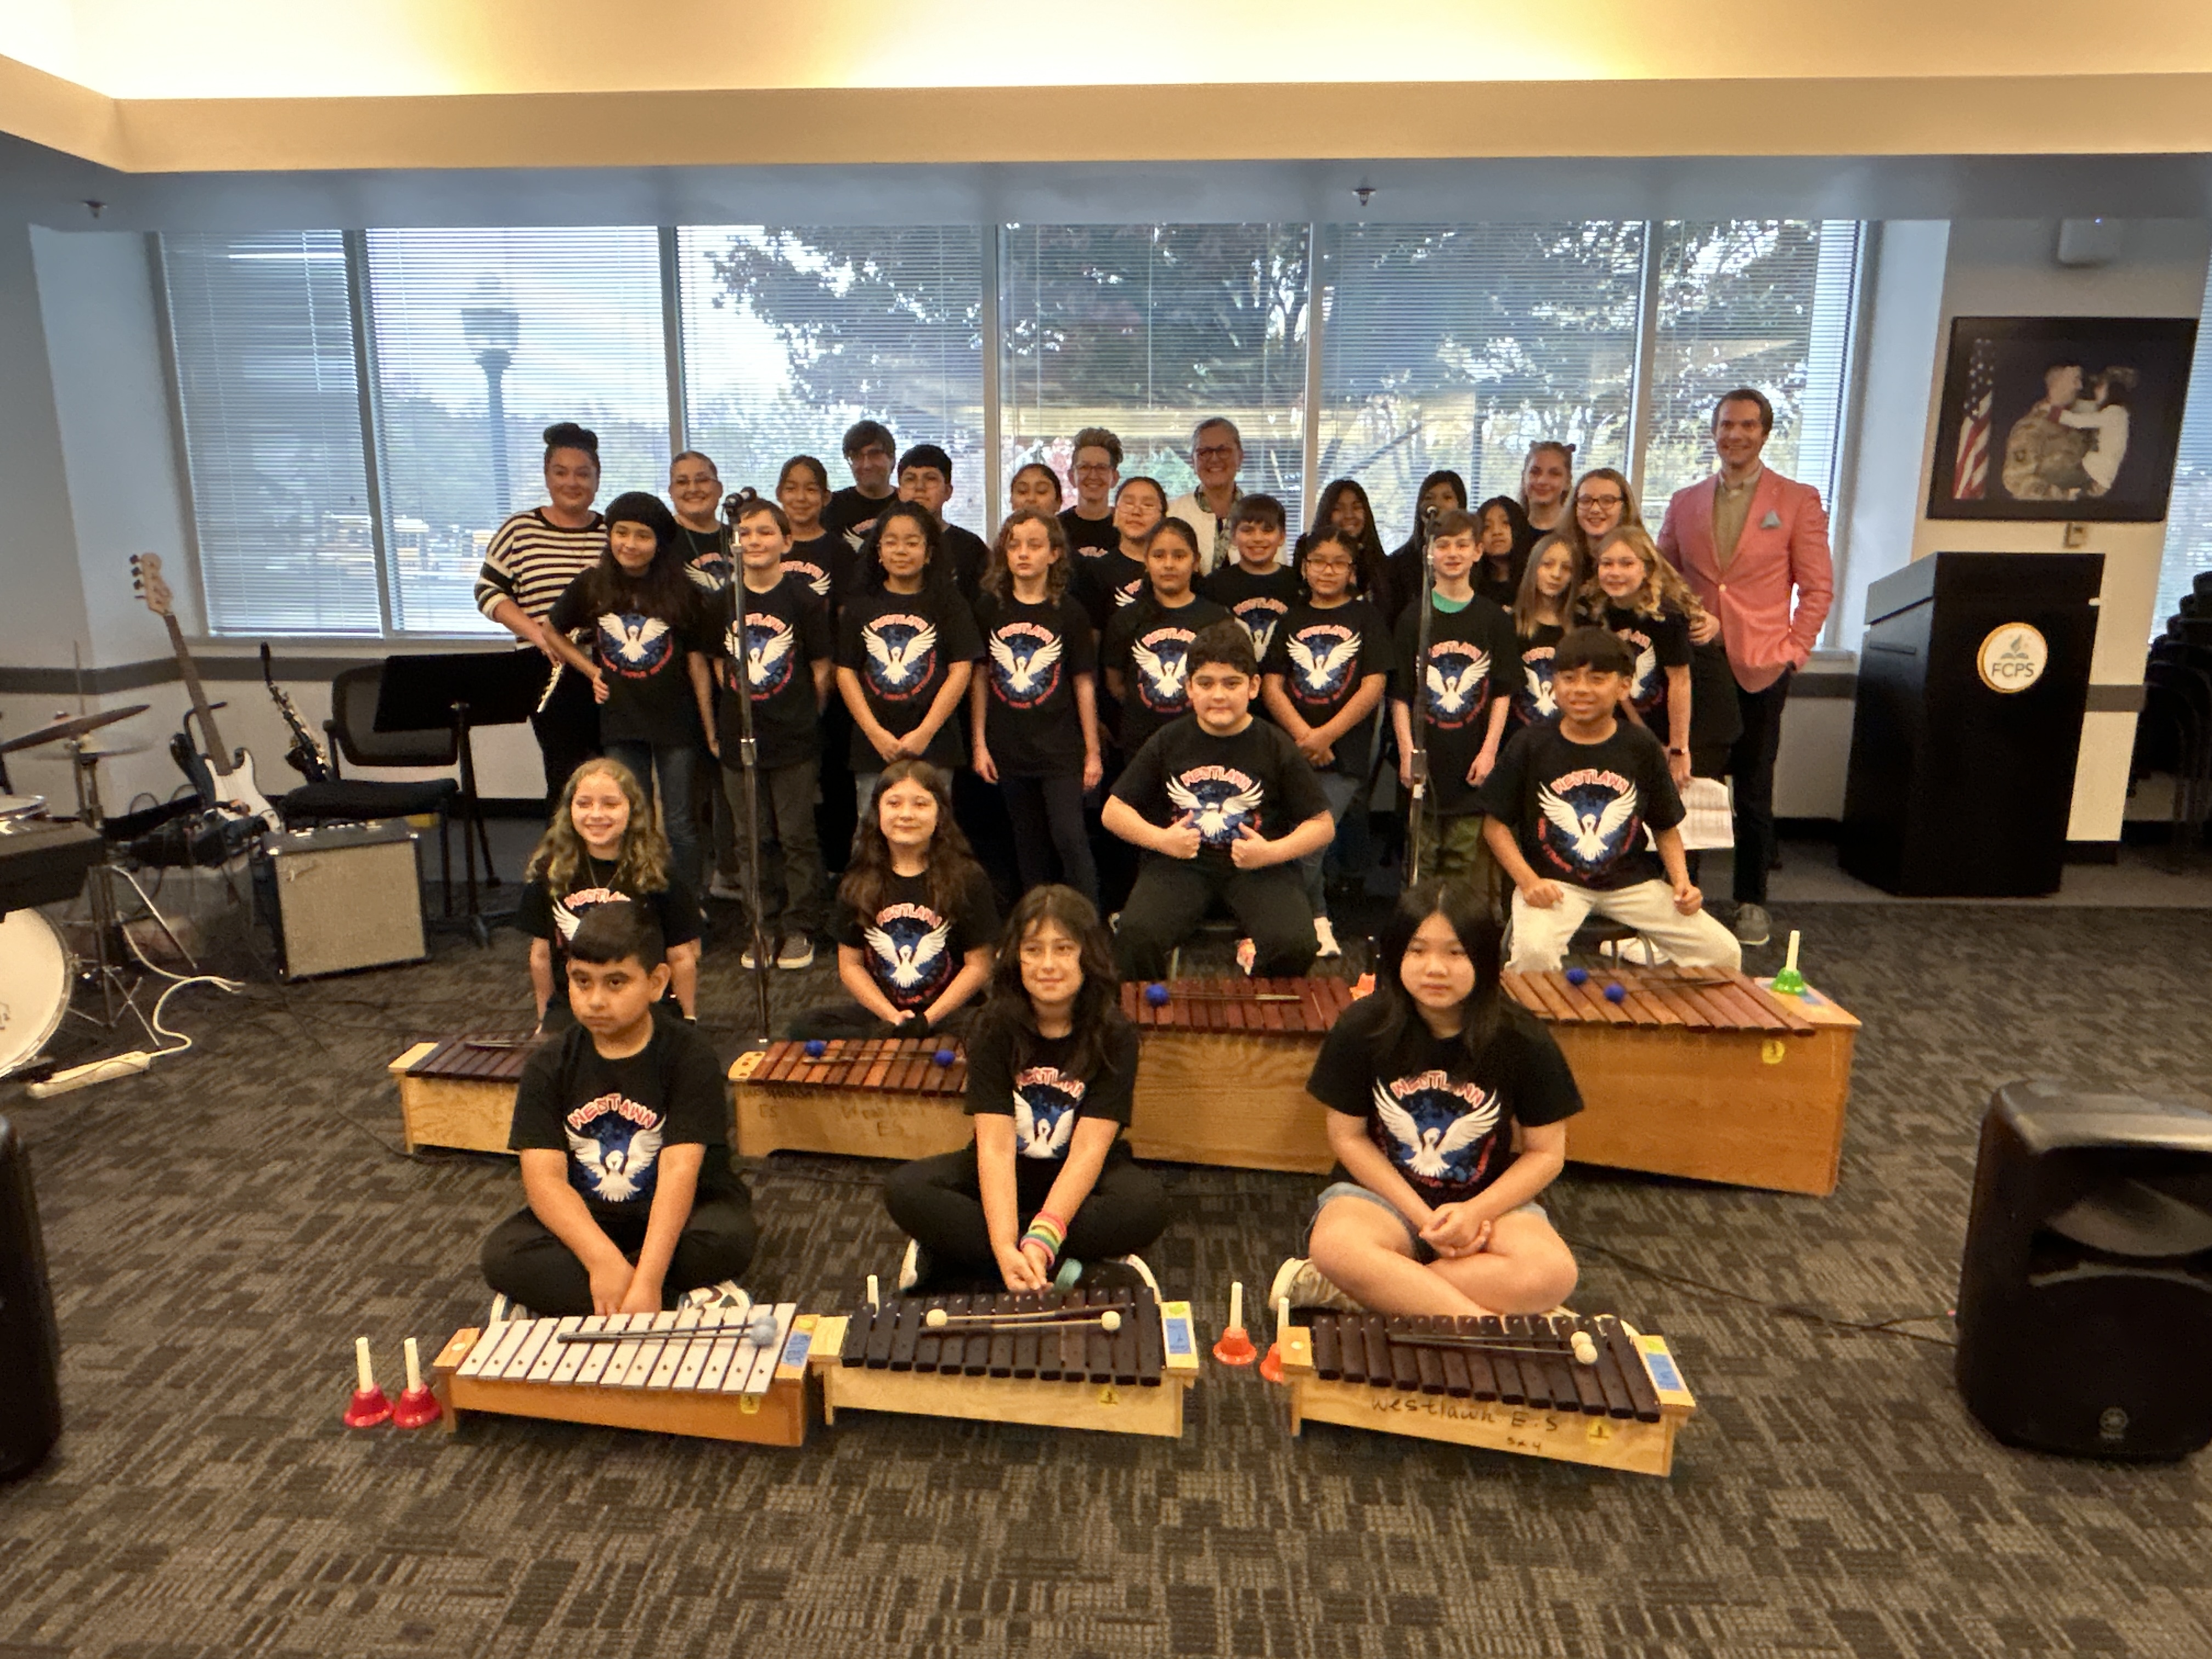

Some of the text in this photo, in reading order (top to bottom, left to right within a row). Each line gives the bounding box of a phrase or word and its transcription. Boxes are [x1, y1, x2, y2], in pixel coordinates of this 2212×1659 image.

[1991, 662, 2035, 678] FCPS
[1180, 765, 1252, 792] WESTLAWN
[1550, 768, 1629, 795] WESTLAWN
[1390, 1070, 1485, 1109] WESTLWN
[567, 1093, 657, 1130] WESTAWN
[1371, 1396, 1496, 1424] Westlawn
